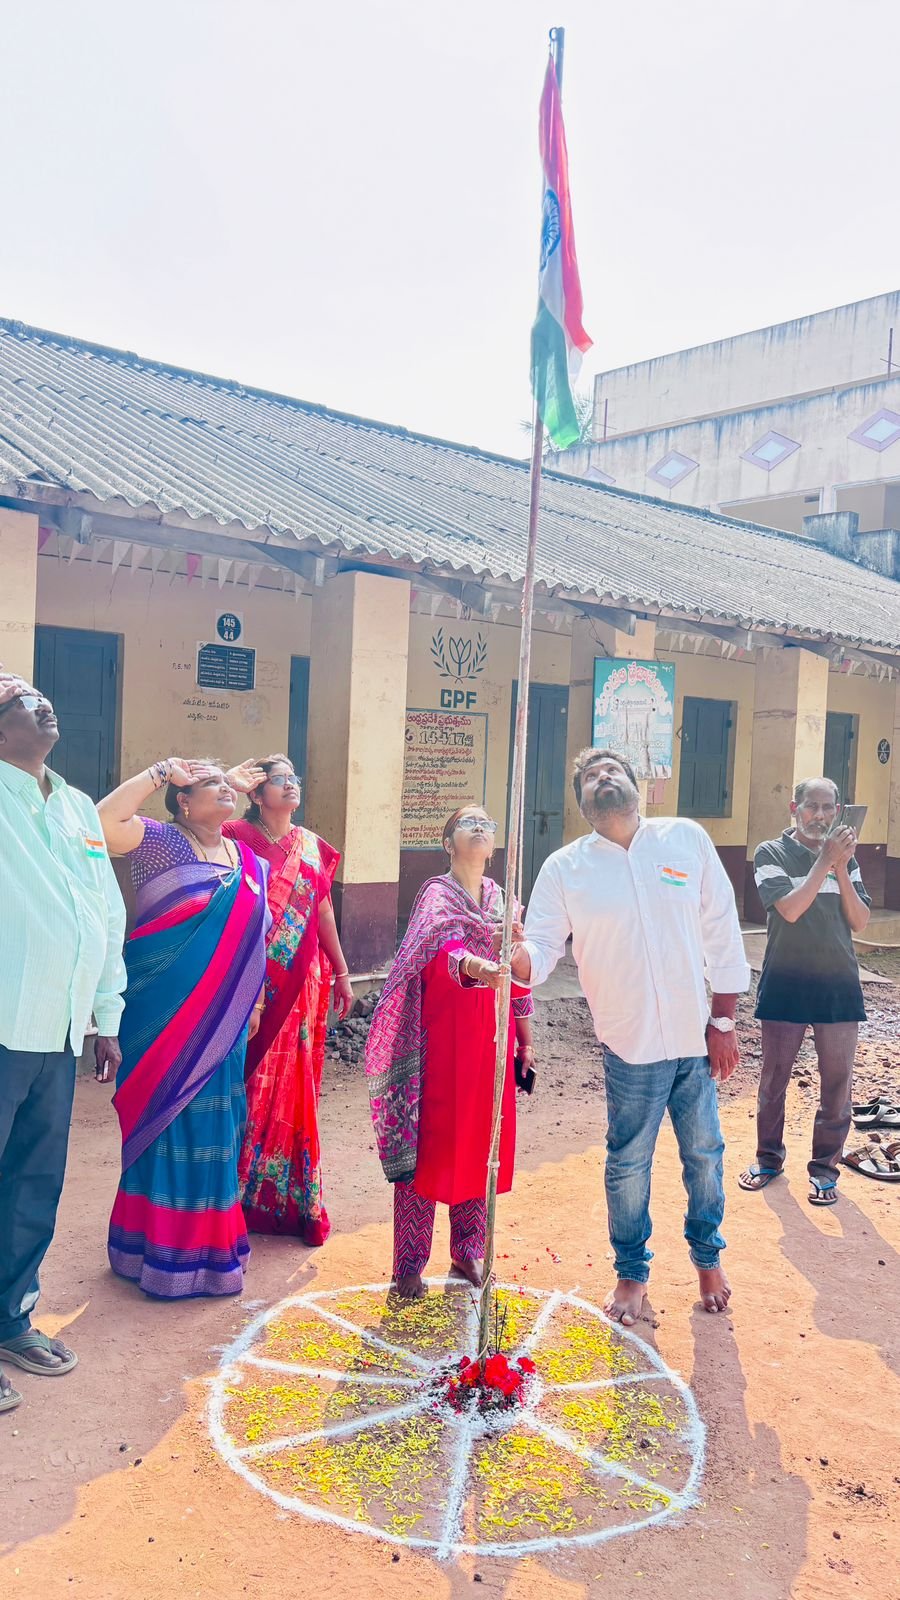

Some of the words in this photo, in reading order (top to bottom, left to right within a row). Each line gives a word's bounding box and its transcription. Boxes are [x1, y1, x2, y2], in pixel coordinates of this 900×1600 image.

[222, 618, 236, 628] 145
[223, 631, 235, 641] 44
[440, 689, 477, 709] CPF
[419, 731, 465, 745] 14417
